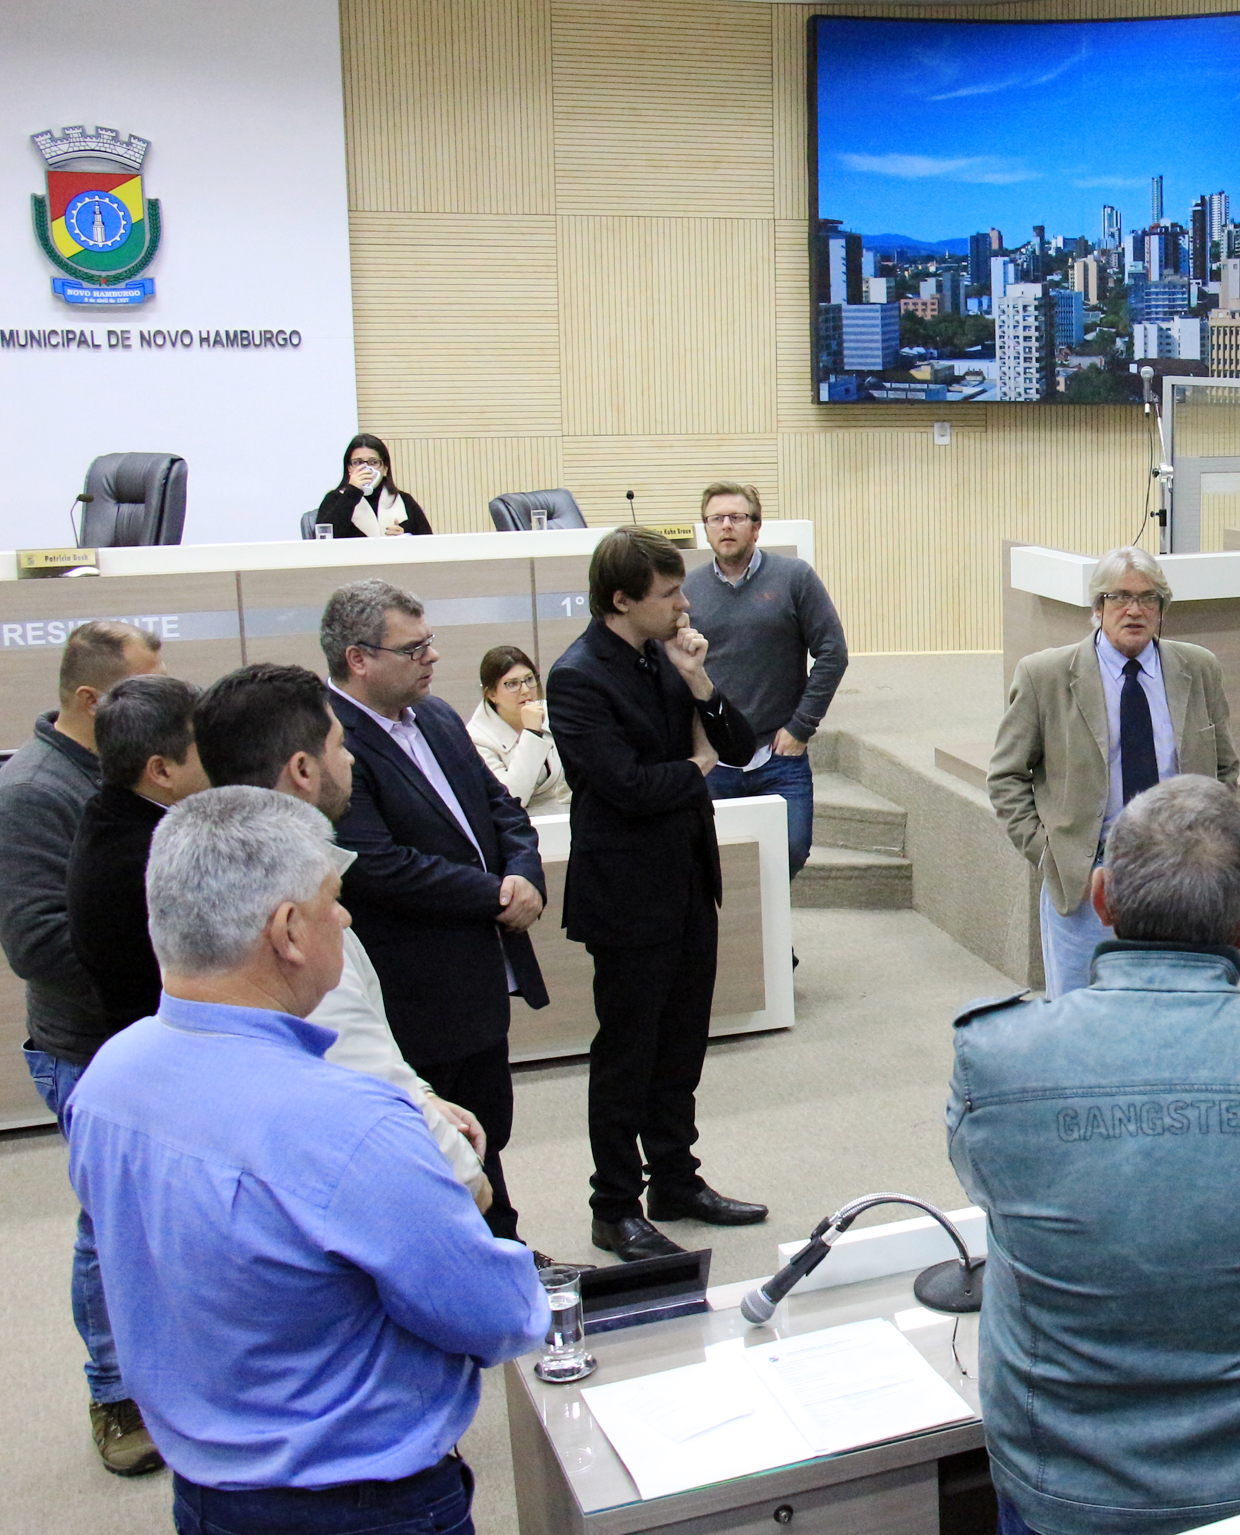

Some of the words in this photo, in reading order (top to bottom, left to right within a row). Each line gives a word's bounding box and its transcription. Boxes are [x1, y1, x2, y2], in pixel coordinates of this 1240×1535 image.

[0, 329, 102, 349] MUNICIPAL
[107, 329, 132, 349] DE
[139, 329, 194, 349] NOVO
[199, 329, 303, 349] HAMBURGO
